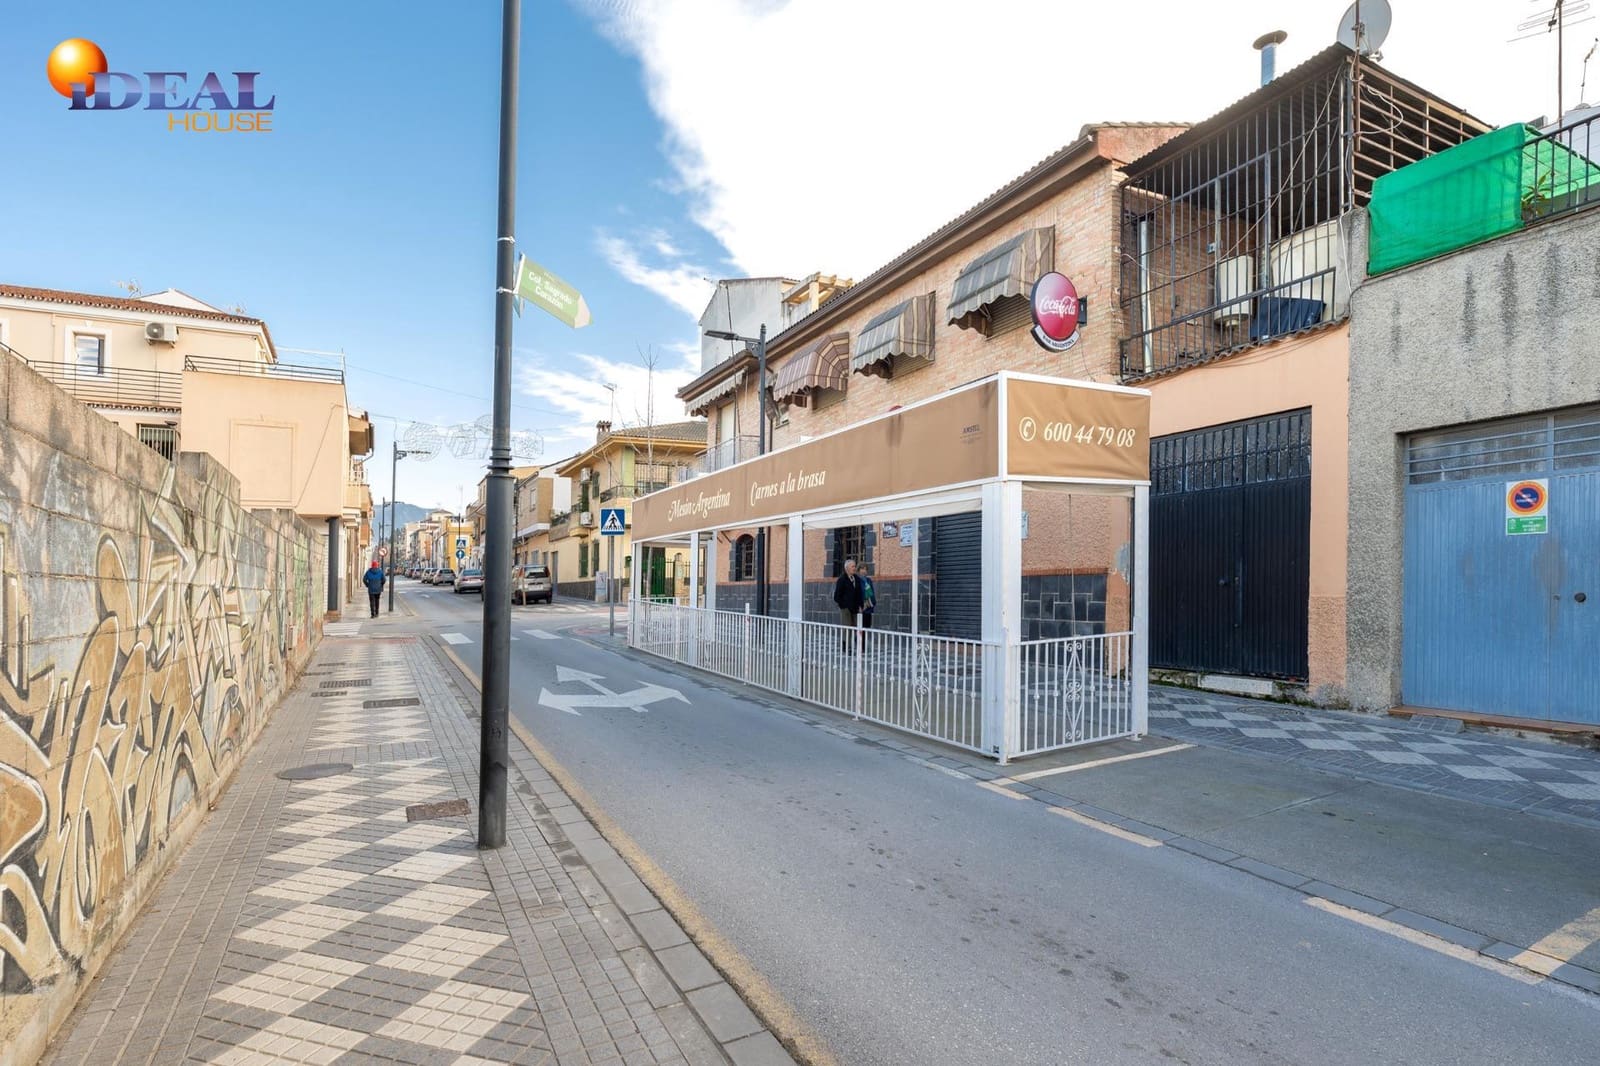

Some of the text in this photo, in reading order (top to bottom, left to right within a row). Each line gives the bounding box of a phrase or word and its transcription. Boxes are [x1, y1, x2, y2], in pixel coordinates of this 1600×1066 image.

[543, 280, 573, 305] Sagrado
[1044, 422, 1136, 448] 600 44 79 08
[750, 470, 826, 507] Carnes a la brasa
[691, 488, 731, 519] Argentina
